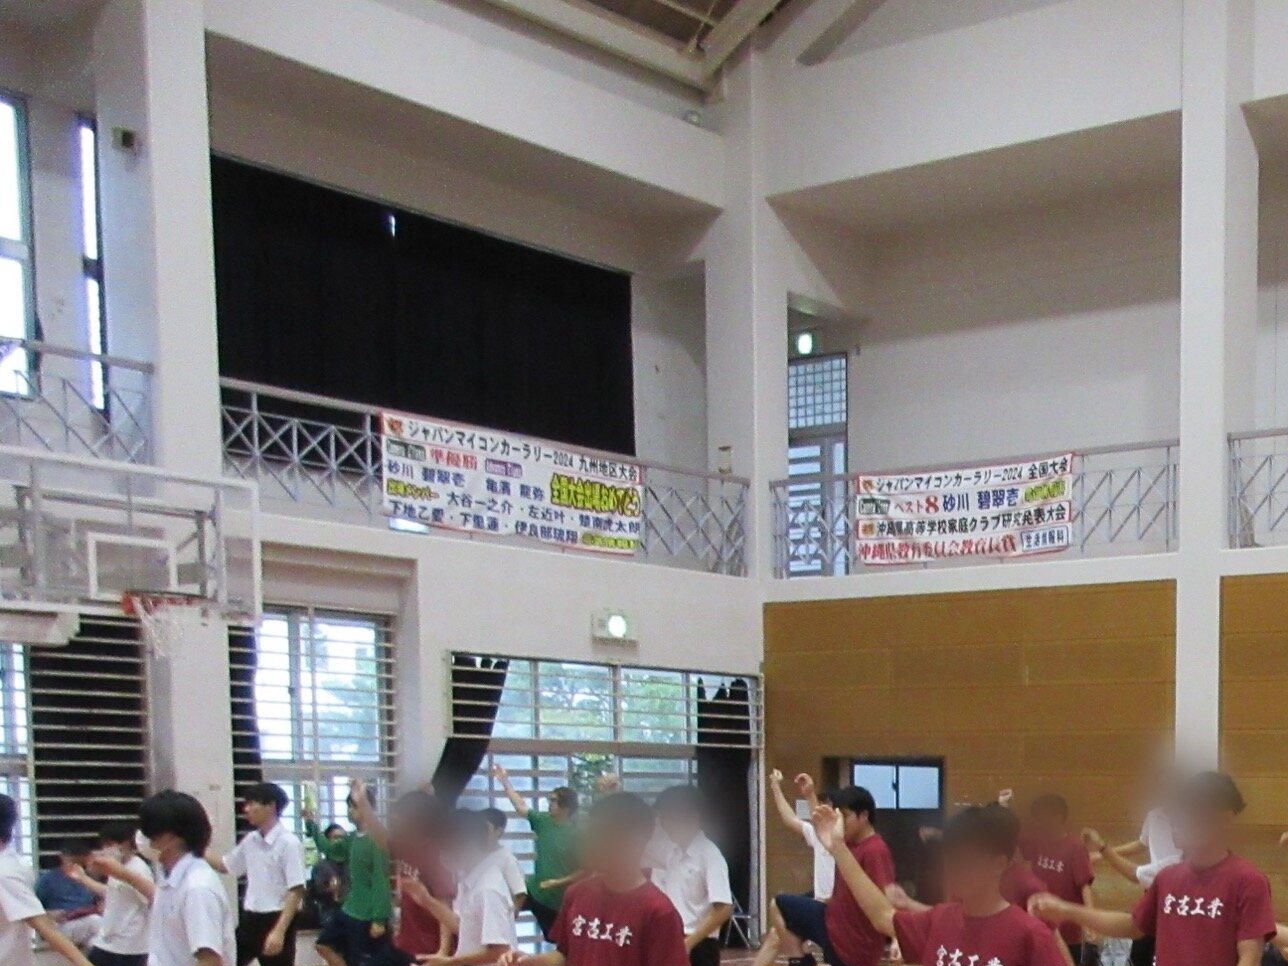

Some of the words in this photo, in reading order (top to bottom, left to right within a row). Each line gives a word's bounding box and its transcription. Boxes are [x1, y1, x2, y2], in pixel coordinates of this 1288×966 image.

[578, 457, 638, 482] 九州地区大会
[1028, 457, 1068, 480] 全国大会
[1163, 893, 1224, 919] 宮古工業
[571, 914, 633, 948] 宮古工業
